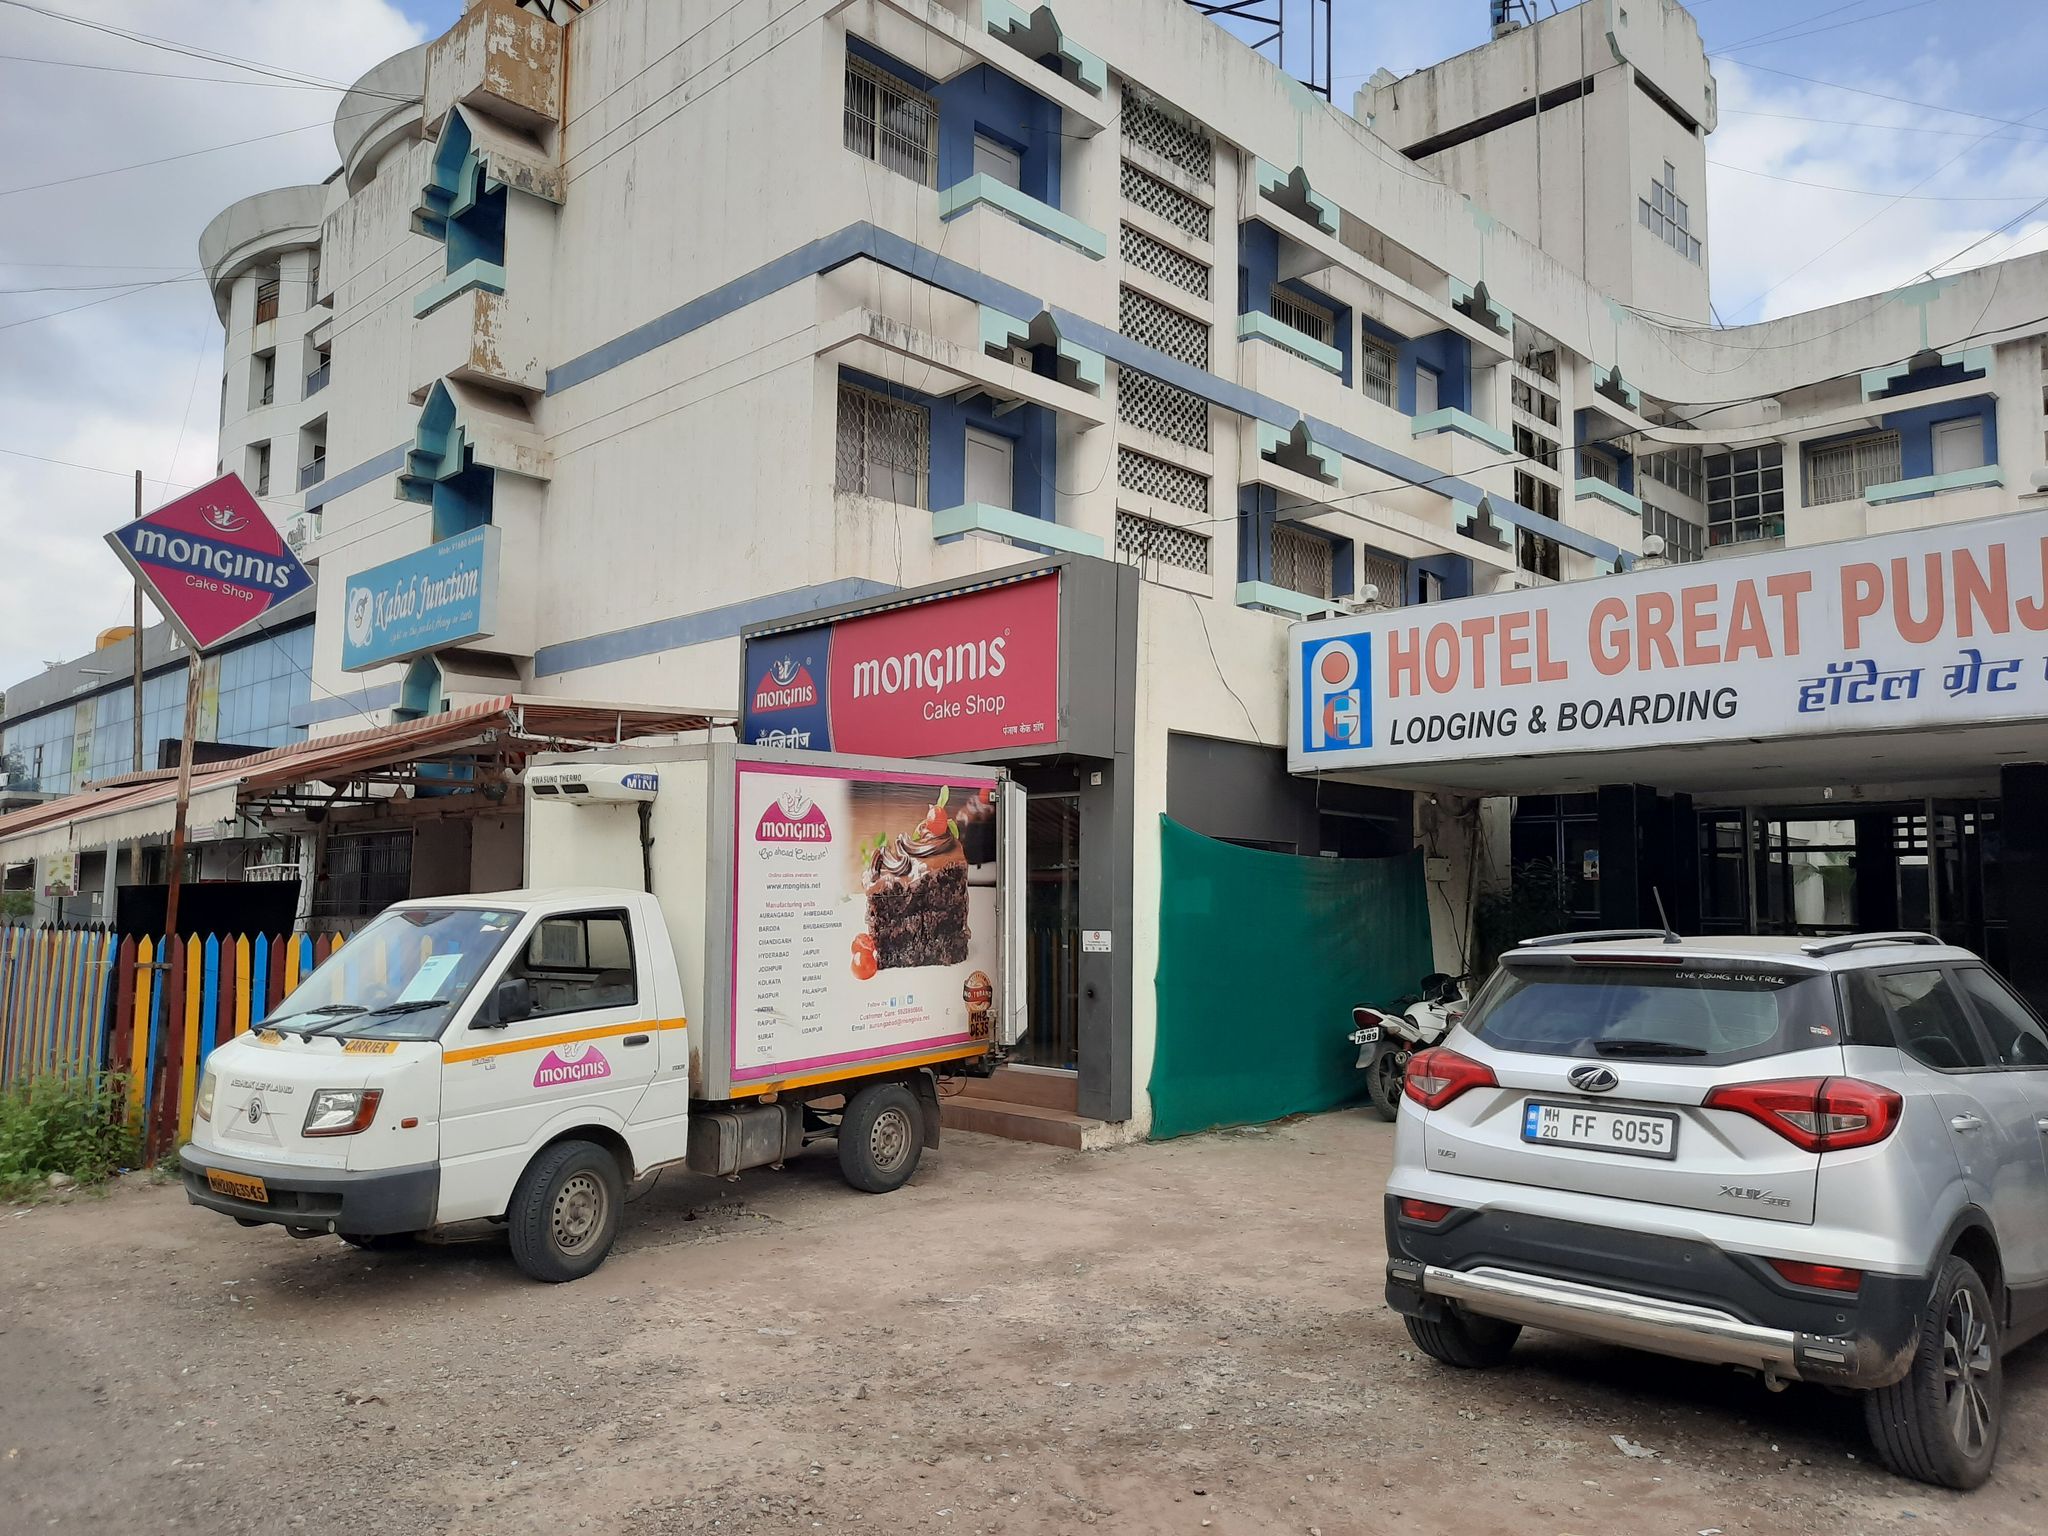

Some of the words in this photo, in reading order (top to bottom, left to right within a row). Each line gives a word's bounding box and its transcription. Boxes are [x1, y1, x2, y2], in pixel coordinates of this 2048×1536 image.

[185, 575, 218, 592] Cake
[222, 583, 254, 602] Shop
[375, 574, 417, 631] Kabab
[416, 560, 479, 620] Junction
[1388, 607, 1568, 698] HOTEL
[1588, 570, 1813, 676] GREAT
[1798, 659, 1925, 713] हॉटेल
[1943, 648, 2024, 698] ग्रेट
[923, 700, 961, 721] Cake
[965, 694, 1005, 716] Shop
[1390, 706, 1517, 746] LODGING
[1528, 705, 1547, 735] &
[1556, 686, 1738, 733] BOARDING
[559, 774, 582, 783] THERMO
[626, 778, 657, 790] MINI
[767, 882, 821, 891] www.monginis.net
[766, 901, 802, 909] Manufacturing
[1759, 976, 1785, 984] FREE
[1357, 1032, 1377, 1043] 7989
[345, 1040, 389, 1054] CARRIER
[1544, 1108, 1560, 1122] MH
[1543, 1125, 1558, 1138] 20
[1572, 1114, 1597, 1137] FF
[1612, 1119, 1664, 1146] 6055
